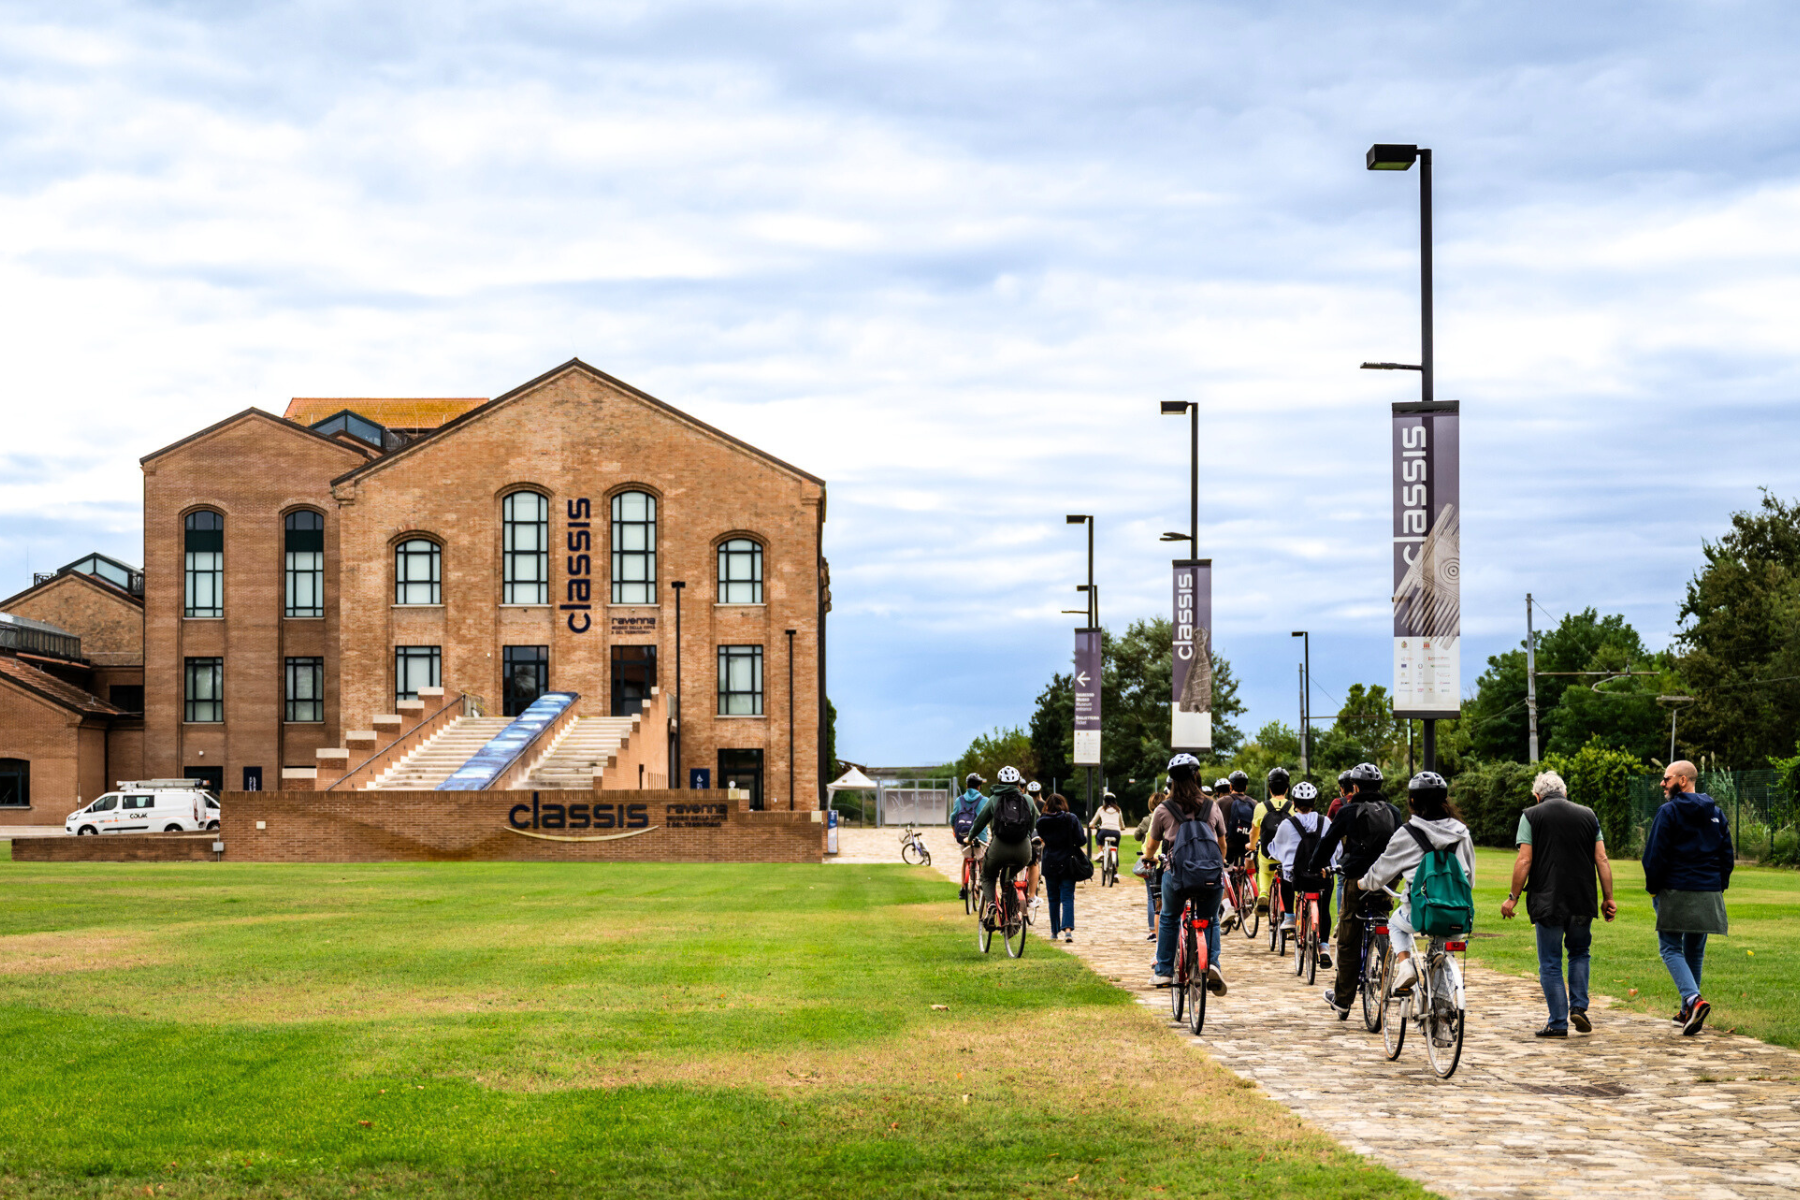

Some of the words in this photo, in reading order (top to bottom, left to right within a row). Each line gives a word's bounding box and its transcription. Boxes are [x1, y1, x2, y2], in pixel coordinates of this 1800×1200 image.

[560, 498, 591, 634] classis
[611, 617, 656, 625] ravenna
[1172, 573, 1193, 660] classis
[508, 791, 649, 829] classis
[666, 803, 728, 814] ravenna
